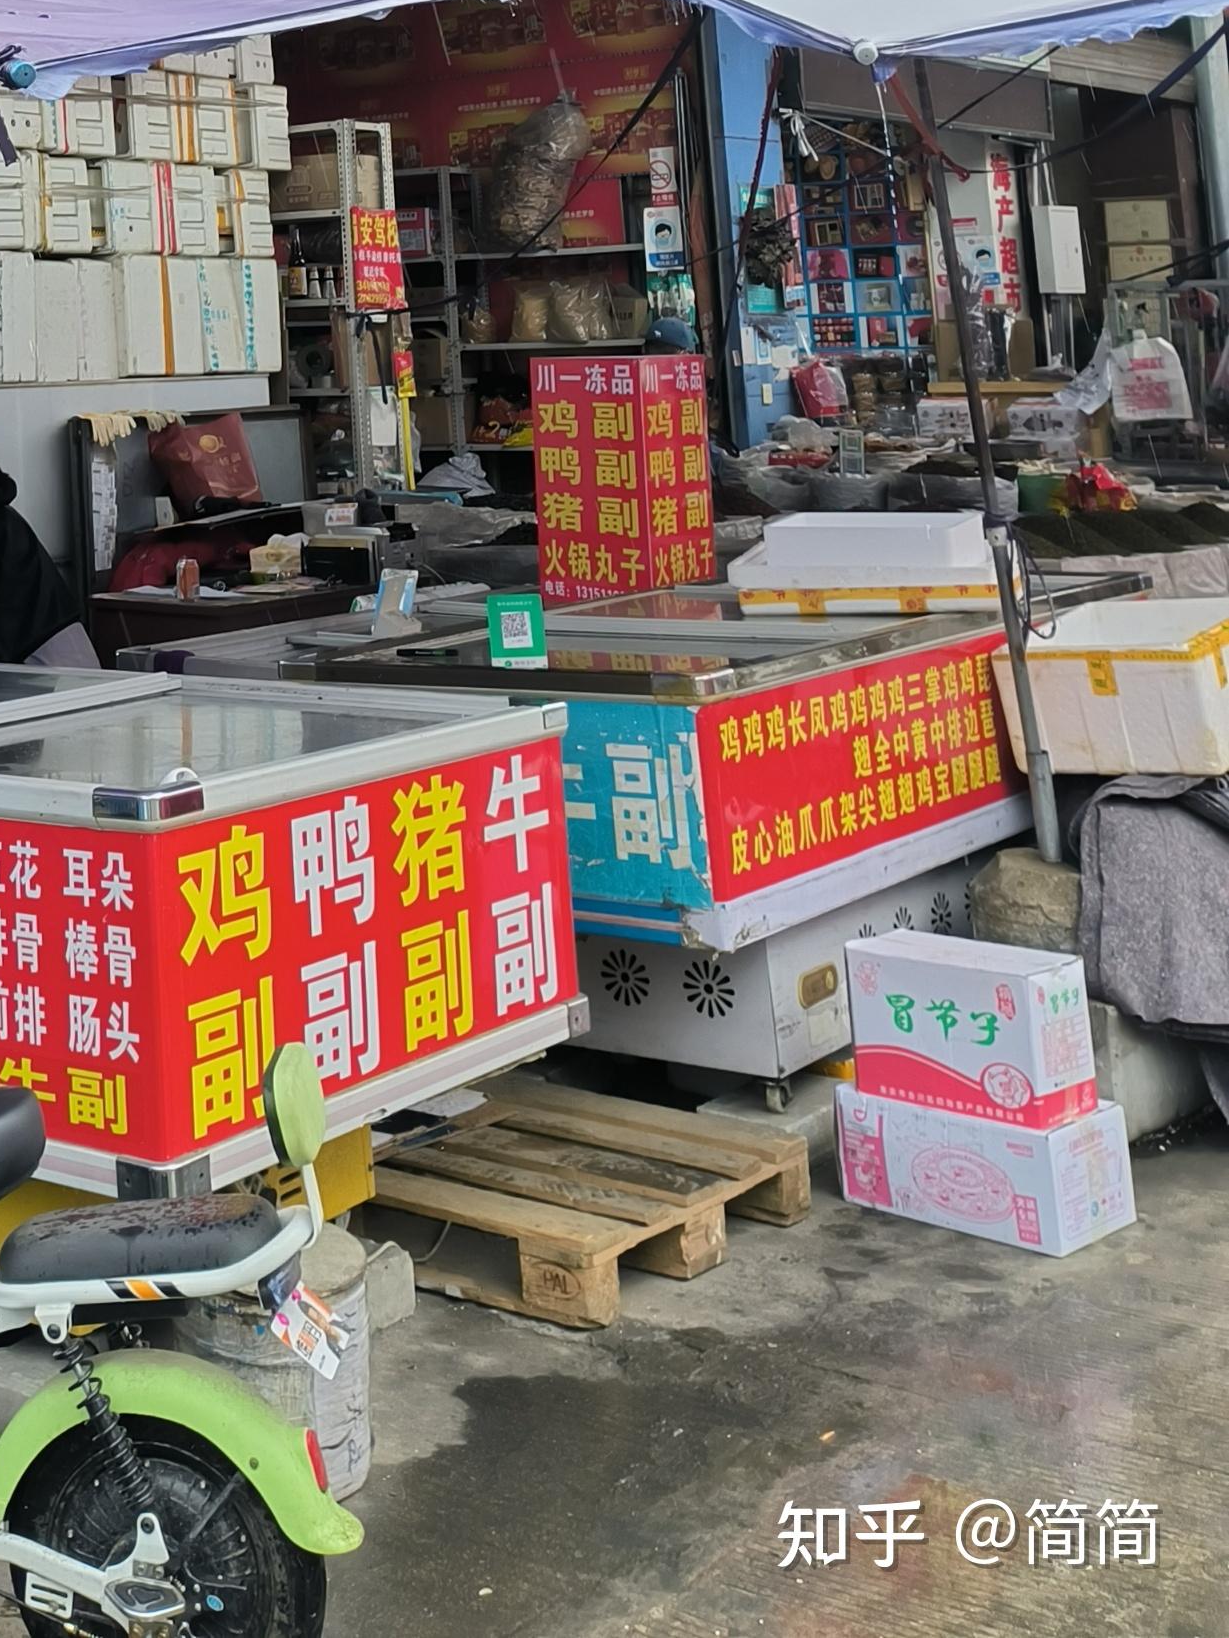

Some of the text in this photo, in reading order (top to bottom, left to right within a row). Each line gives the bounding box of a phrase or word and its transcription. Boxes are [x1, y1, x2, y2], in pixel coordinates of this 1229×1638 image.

[536, 363, 635, 396] 川一冻品
[644, 360, 704, 394] 川一冻品
[537, 400, 636, 443] 鸡副
[646, 397, 704, 440] 鸡副
[540, 445, 638, 490] 鸭副
[648, 444, 707, 490] 鸭副
[542, 492, 641, 540] 猪副
[651, 490, 710, 539] 猪副
[544, 539, 646, 588] 火锅丸子
[654, 538, 714, 588] 火锅丸子
[62, 847, 135, 912] 耳朵
[483, 753, 559, 1017] 牛副
[290, 794, 382, 1082] 鸭副
[390, 773, 474, 1054] 猪副
[64, 917, 137, 989] 棒骨
[177, 824, 277, 1141] 鸡副
[68, 993, 141, 1064] 肠头
